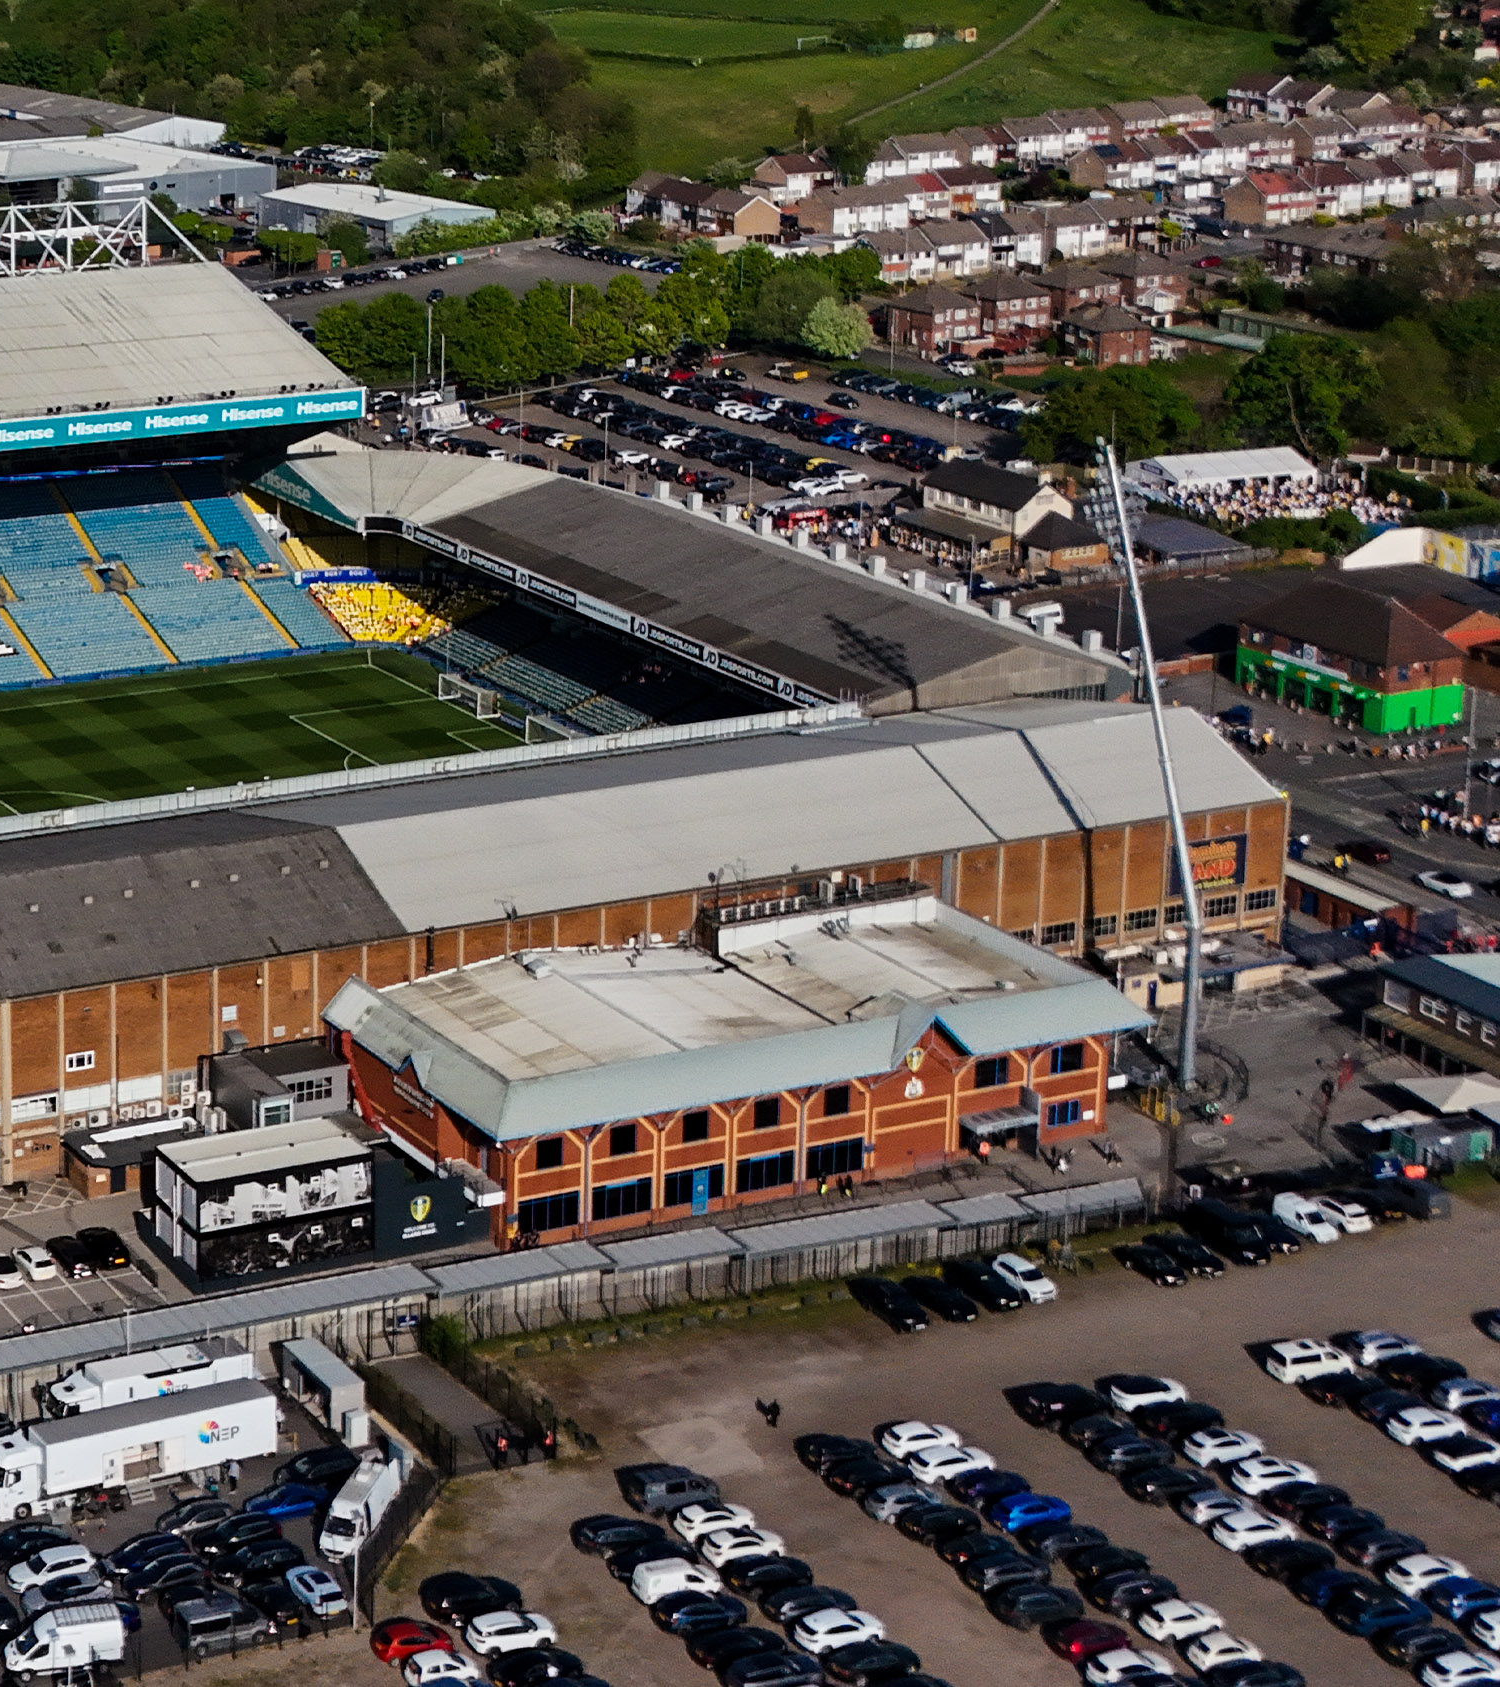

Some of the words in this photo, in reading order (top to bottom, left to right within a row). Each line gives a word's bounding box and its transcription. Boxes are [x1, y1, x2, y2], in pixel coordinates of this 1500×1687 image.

[221, 406, 284, 422] Hisense
[296, 399, 359, 416] Hisense
[68, 420, 133, 436] Hisense
[145, 412, 209, 429] Hisense
[649, 628, 700, 657] JDSPORTS.COM
[719, 658, 774, 689] JDSPORTS.COM
[1191, 858, 1237, 882] AND
[210, 1425, 240, 1444] NEP
